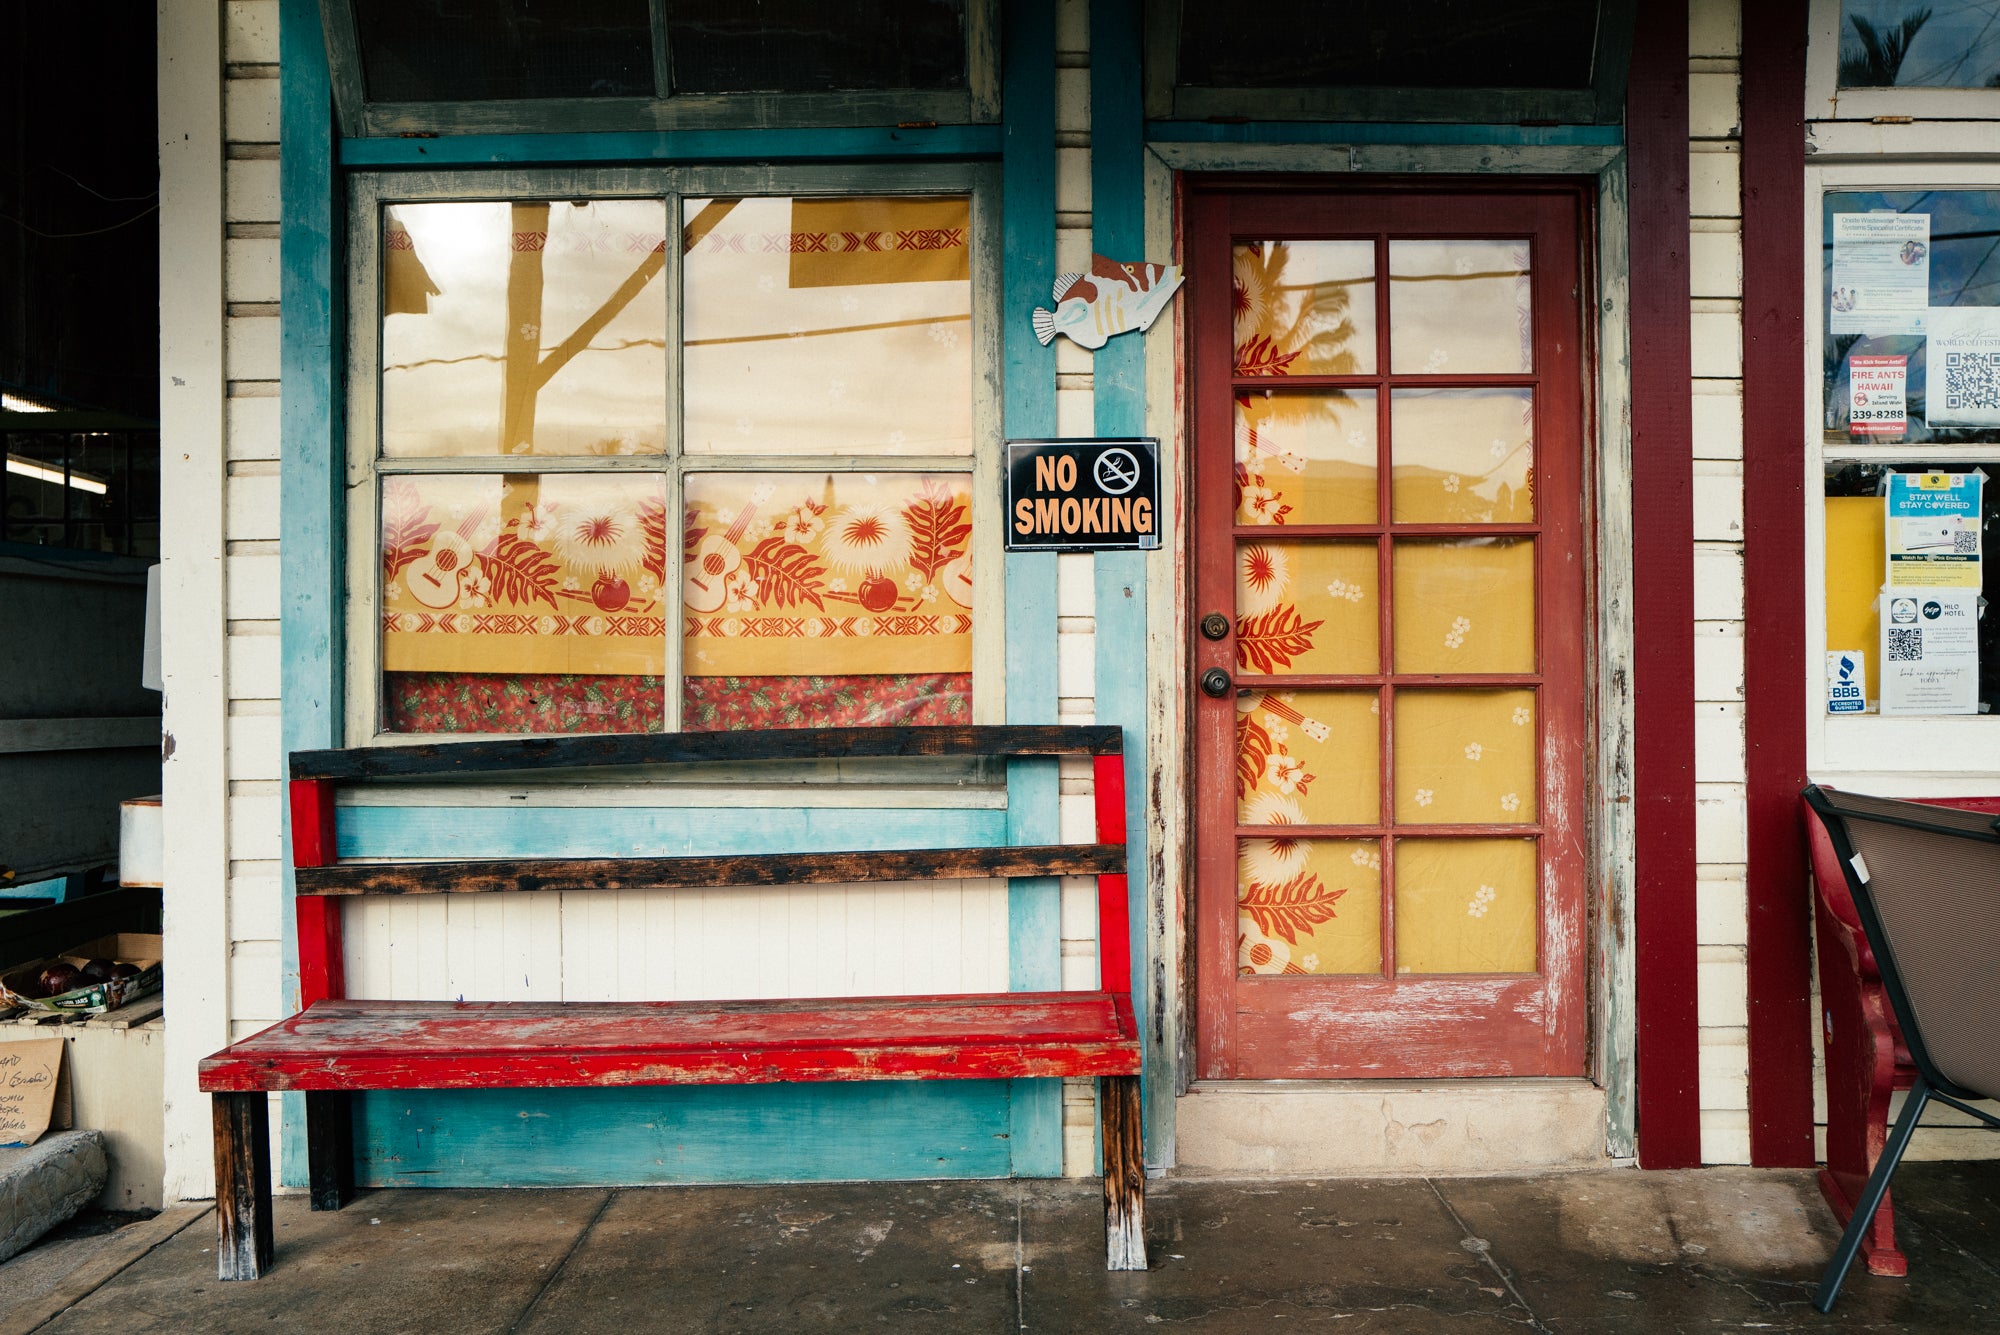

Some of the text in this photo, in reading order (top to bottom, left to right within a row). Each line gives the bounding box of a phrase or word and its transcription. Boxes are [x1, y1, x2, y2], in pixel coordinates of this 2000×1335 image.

[1841, 224, 1867, 232] Systems
[1851, 371, 1905, 379] FIRE ANTS
[1857, 383, 1893, 391] HAWAII
[1852, 410, 1904, 420] 339-8288
[1035, 454, 1078, 492] NO
[1015, 497, 1152, 534] SMOKING
[1832, 687, 1860, 698] BBB
